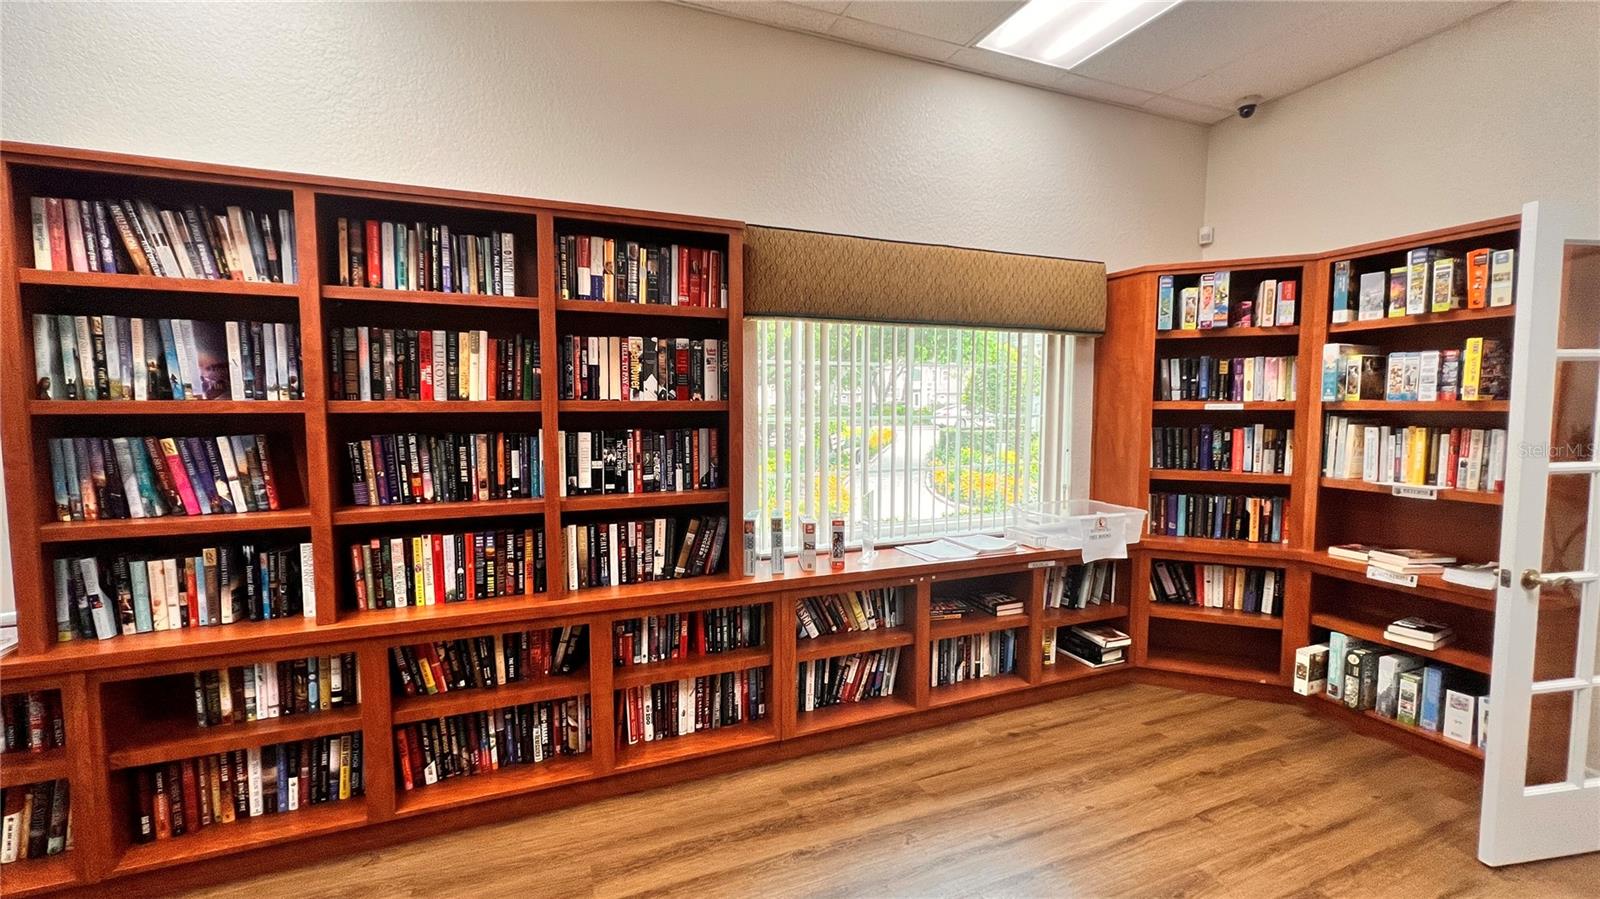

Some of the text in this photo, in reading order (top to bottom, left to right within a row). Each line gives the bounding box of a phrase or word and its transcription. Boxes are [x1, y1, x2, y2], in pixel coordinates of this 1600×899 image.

[110, 205, 137, 250] INFILTRATION
[434, 343, 444, 388] TUROW
[622, 362, 628, 371] TO
